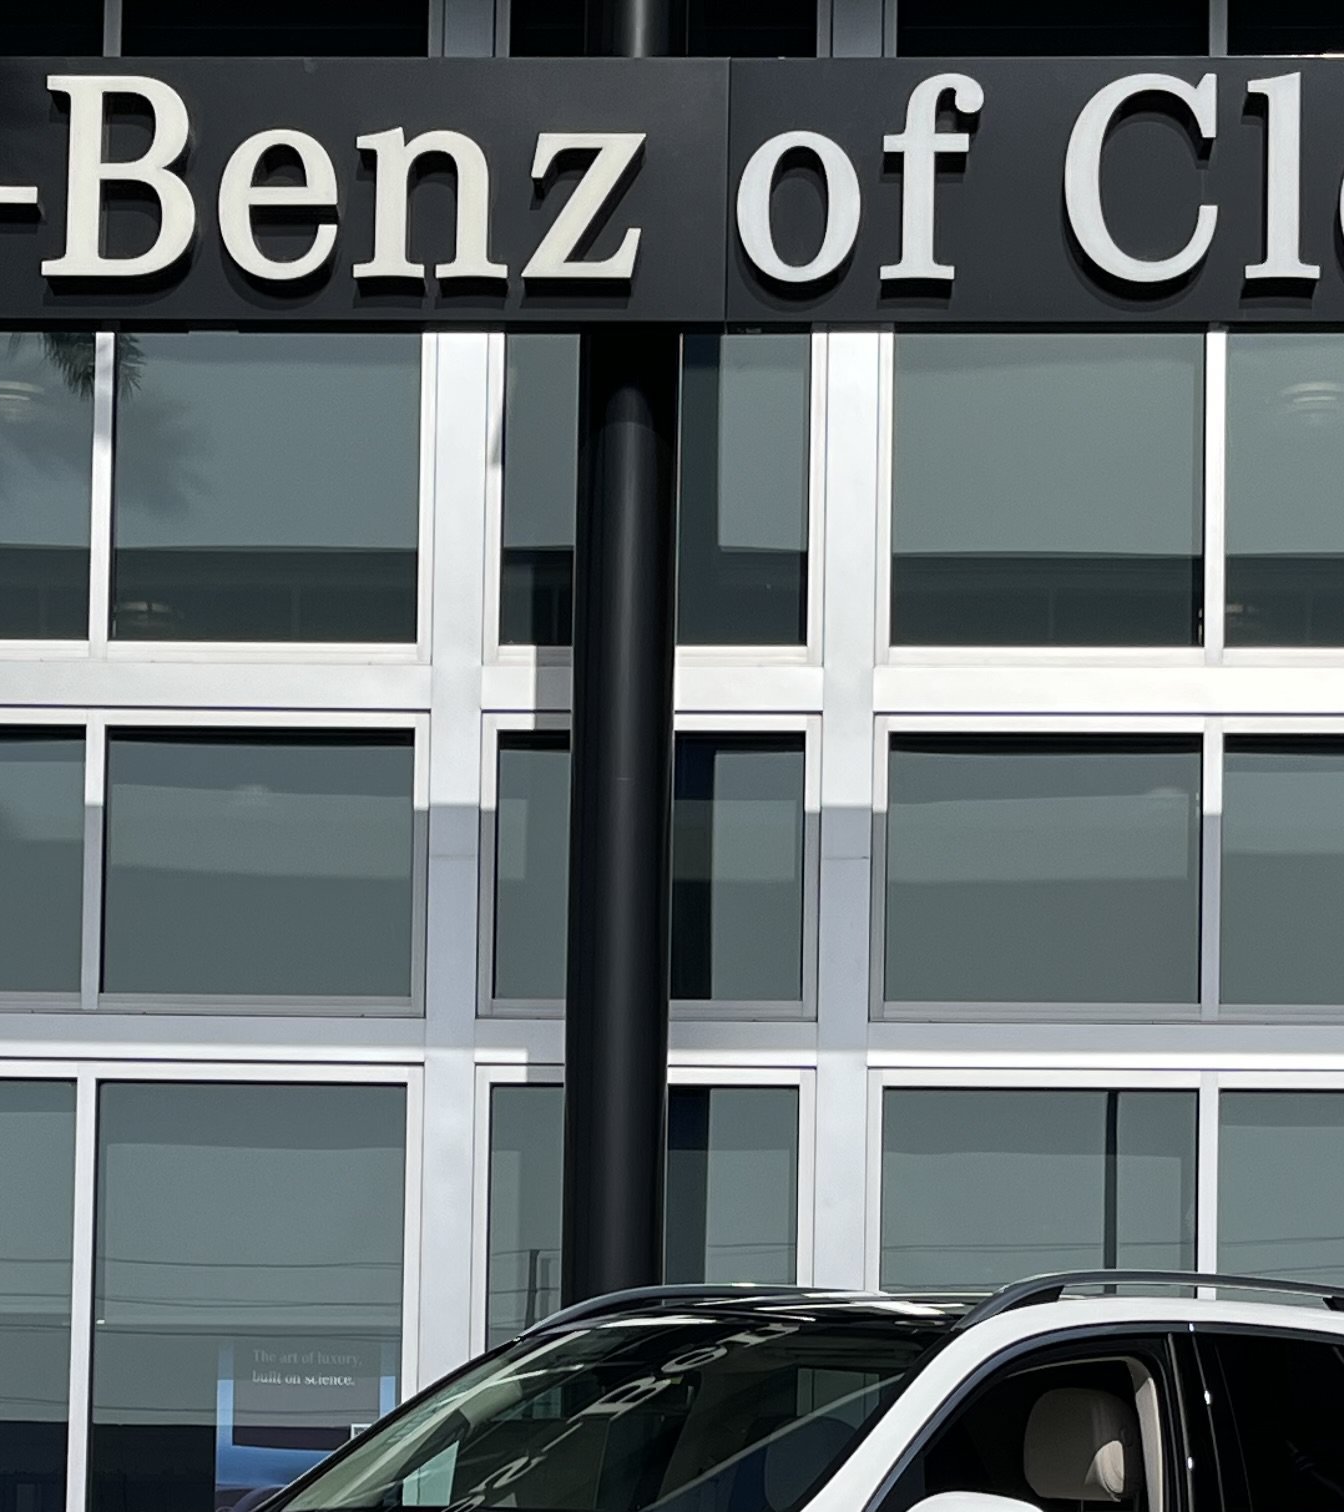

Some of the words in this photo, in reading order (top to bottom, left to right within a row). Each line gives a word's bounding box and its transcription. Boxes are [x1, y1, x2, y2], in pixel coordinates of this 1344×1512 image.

[736, 73, 985, 283] of
[254, 1350, 276, 1363] The
[280, 1353, 297, 1364] art
[301, 1352, 315, 1364] of
[317, 1352, 363, 1367] luxury,
[252, 1370, 281, 1384] built
[285, 1375, 301, 1385] on
[304, 1373, 355, 1386] science.
